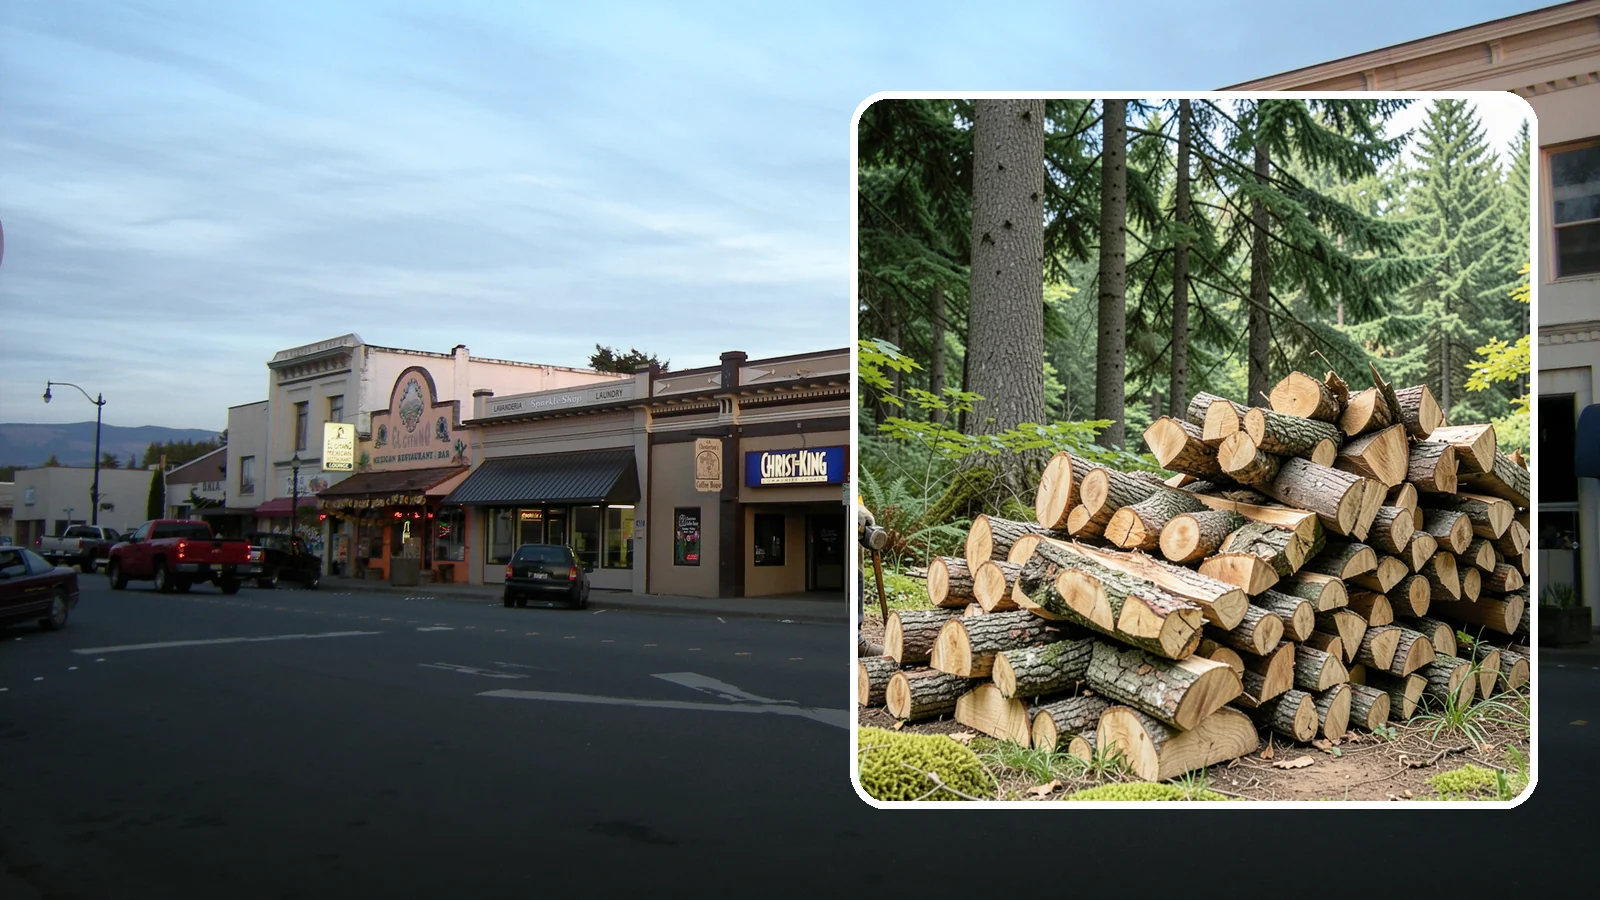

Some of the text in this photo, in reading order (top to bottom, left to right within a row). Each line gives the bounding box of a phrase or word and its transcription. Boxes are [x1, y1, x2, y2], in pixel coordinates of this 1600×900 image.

[493, 389, 624, 413] LAVANDERIA Sparkle Shop LAUNDRY
[373, 450, 450, 464] MEXICAN RESTAURANT BAR
